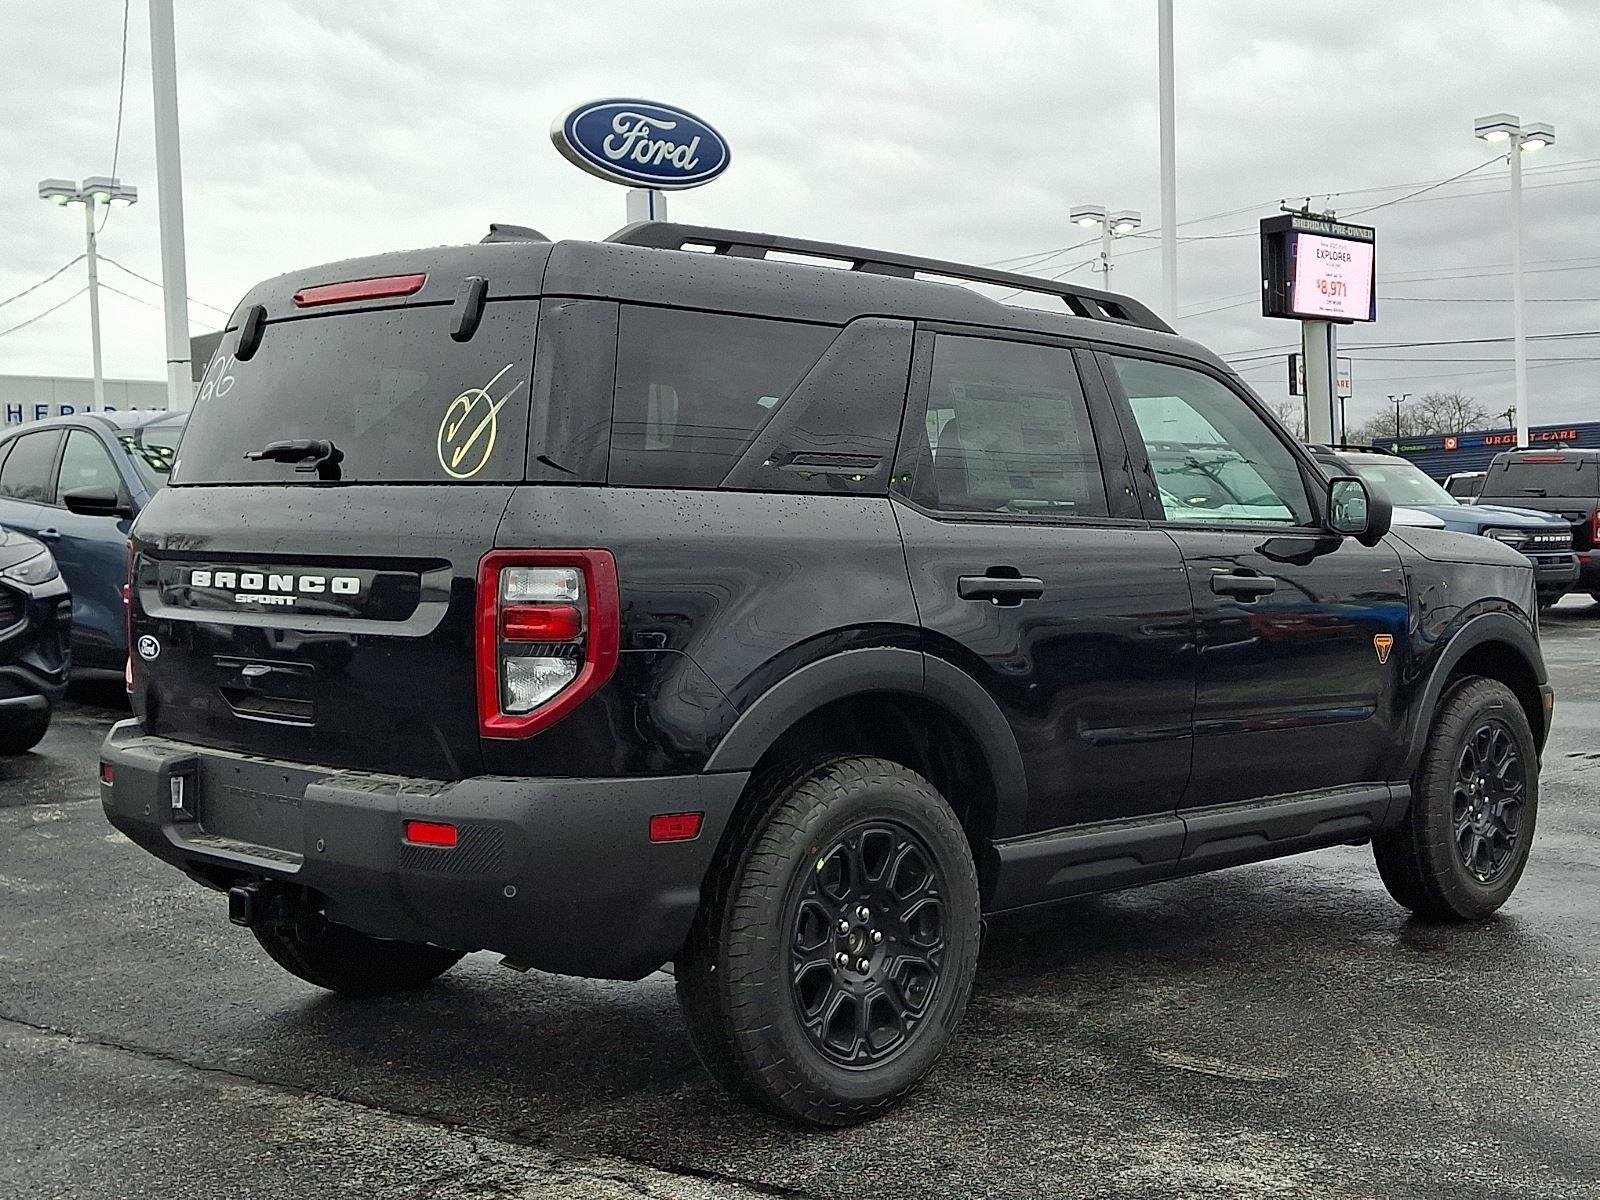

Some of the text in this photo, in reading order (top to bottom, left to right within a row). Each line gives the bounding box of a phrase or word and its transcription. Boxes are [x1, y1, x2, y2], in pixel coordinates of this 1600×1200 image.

[603, 111, 701, 171] Ford
[1292, 218, 1373, 238] SHERIDAN PRE-OWNED
[1316, 248, 1352, 263] EXPLORER
[1317, 279, 1347, 297] $8,971
[1485, 433, 1537, 446] URGET
[1542, 430, 1577, 441] CARE
[191, 570, 361, 595] BRONCO
[234, 593, 299, 606] SPORT
